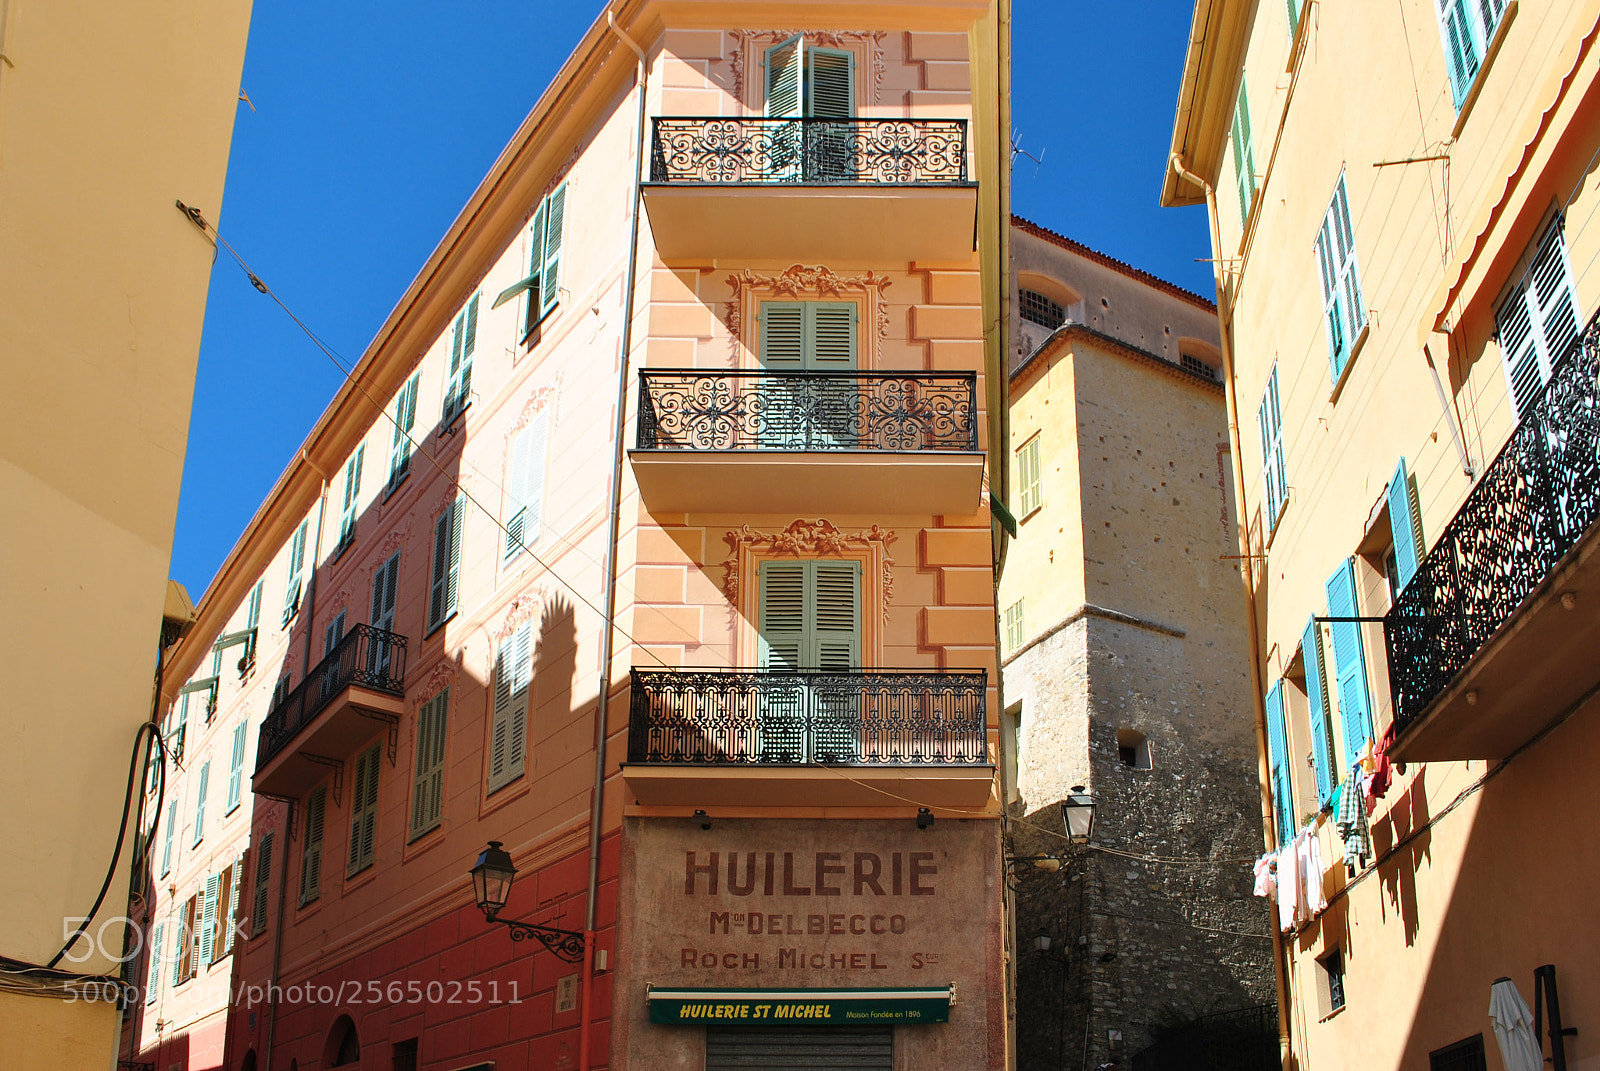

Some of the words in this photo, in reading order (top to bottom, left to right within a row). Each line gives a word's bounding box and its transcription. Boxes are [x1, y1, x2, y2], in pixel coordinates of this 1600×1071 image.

[684, 851, 938, 896] HUILERIE
[680, 948, 760, 969] ROCH
[778, 948, 888, 970] MICHEL
[679, 1004, 750, 1019] HUILERIE
[753, 1004, 771, 1019] ST
[774, 1004, 832, 1019] MICHEL
[846, 1011, 869, 1019] Maison
[905, 1010, 921, 1018] 1896
